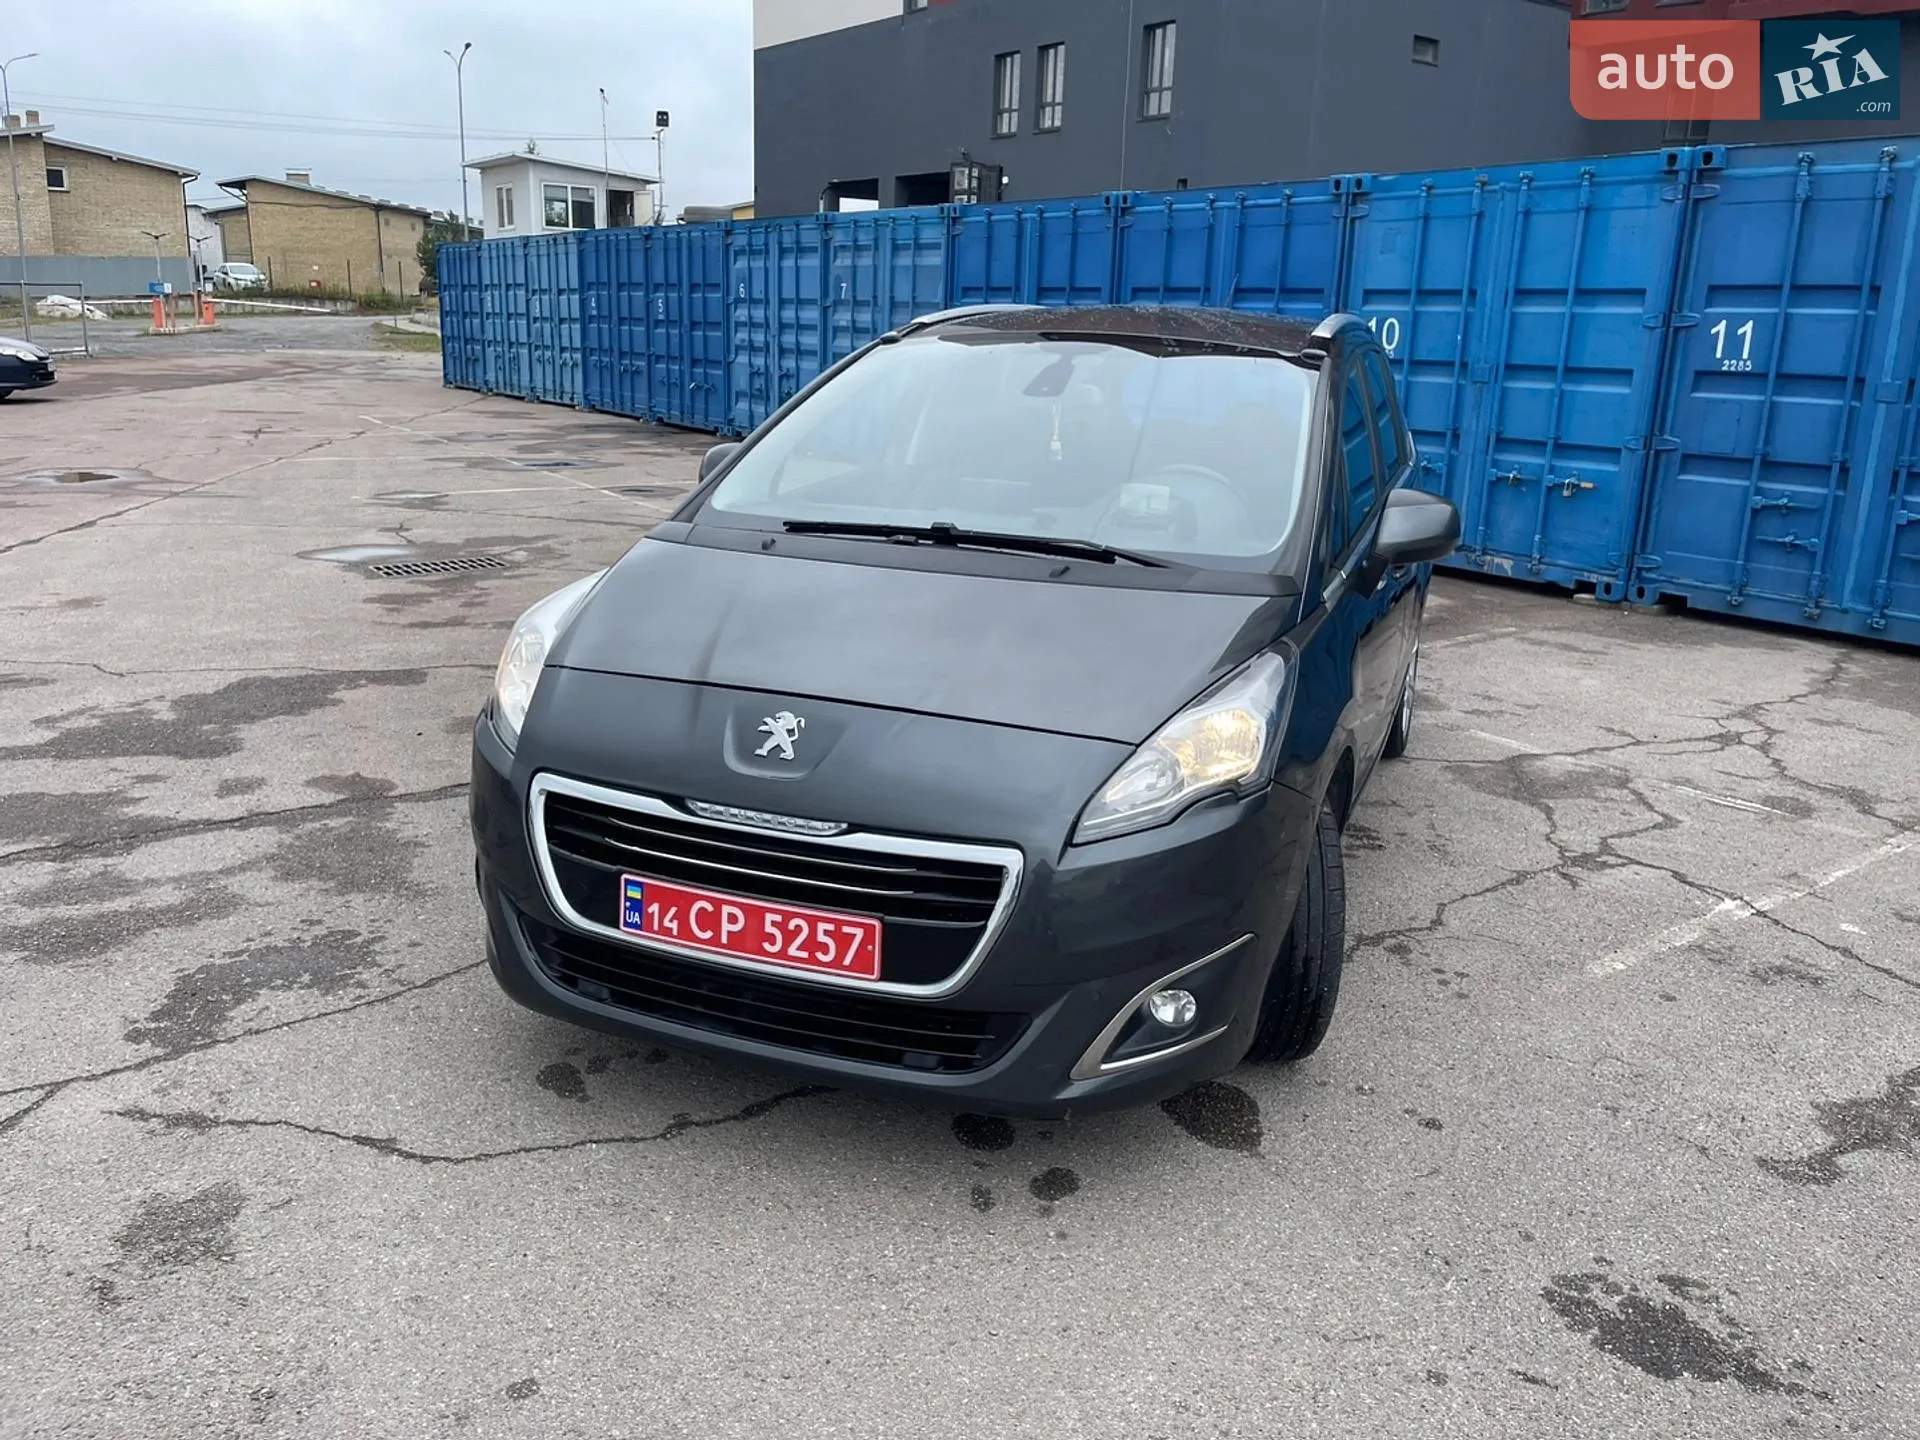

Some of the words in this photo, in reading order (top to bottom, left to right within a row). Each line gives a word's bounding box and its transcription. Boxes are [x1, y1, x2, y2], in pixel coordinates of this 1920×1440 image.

[739, 282, 746, 299] 6
[840, 282, 848, 300] 7
[1710, 319, 1754, 360] 11
[626, 909, 641, 925] UA
[647, 902, 679, 936] 14
[689, 900, 746, 944] CP
[761, 913, 865, 967] 5257
